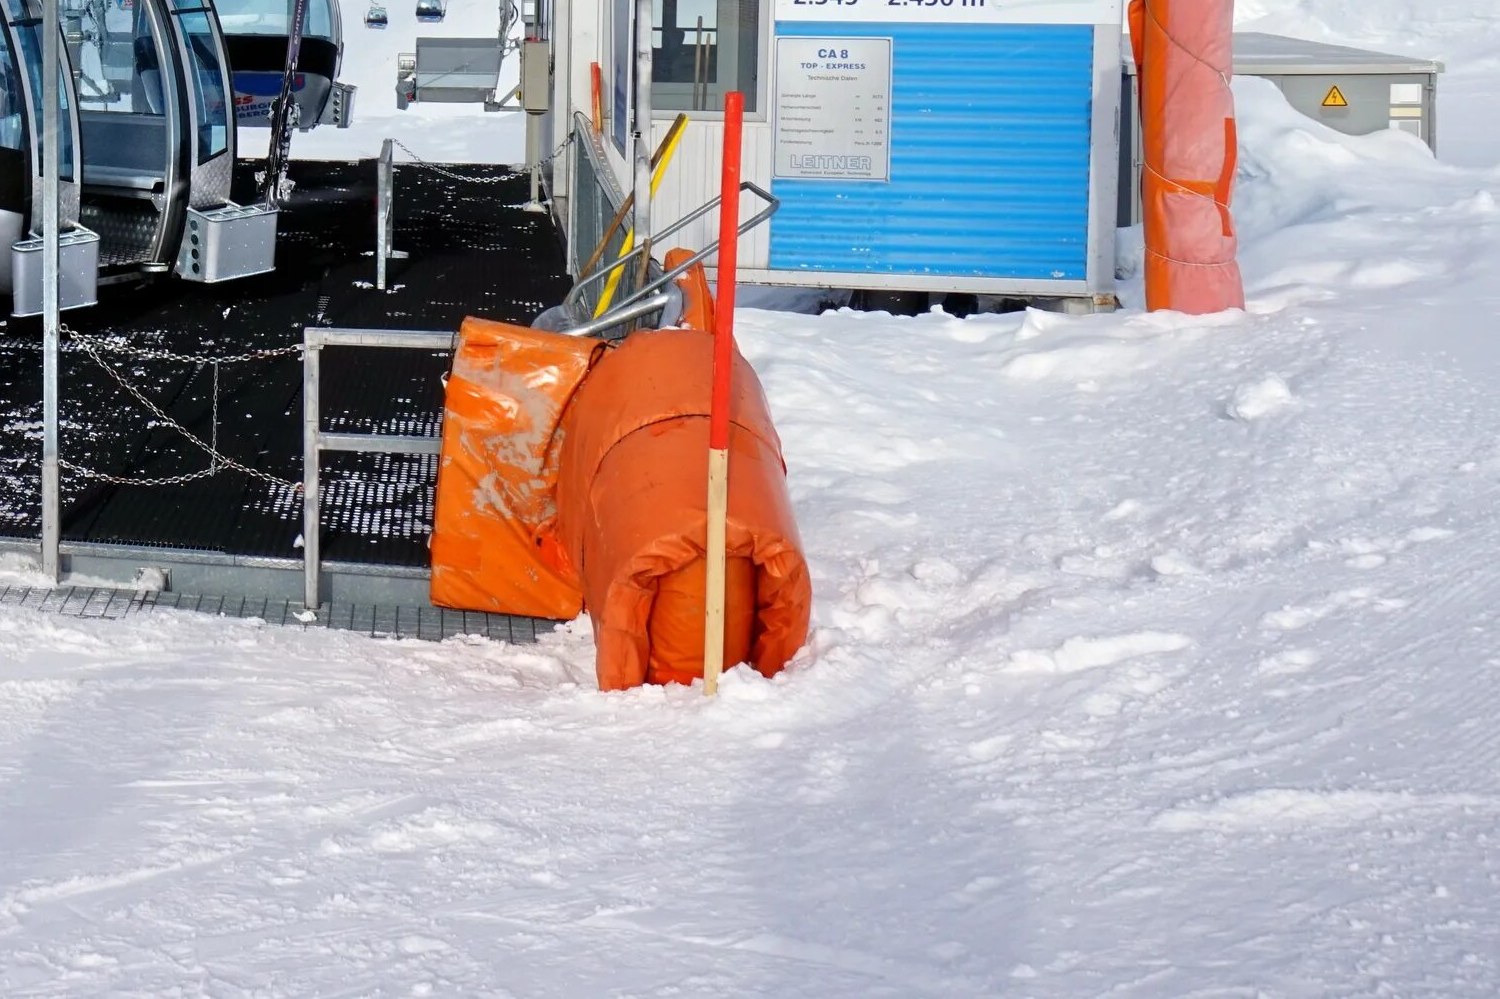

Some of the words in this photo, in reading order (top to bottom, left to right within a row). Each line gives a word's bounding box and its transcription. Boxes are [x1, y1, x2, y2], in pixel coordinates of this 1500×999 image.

[818, 48, 837, 59] CA
[840, 49, 849, 59] 8
[800, 62, 818, 70] TOP
[790, 153, 872, 171] LEITNER
